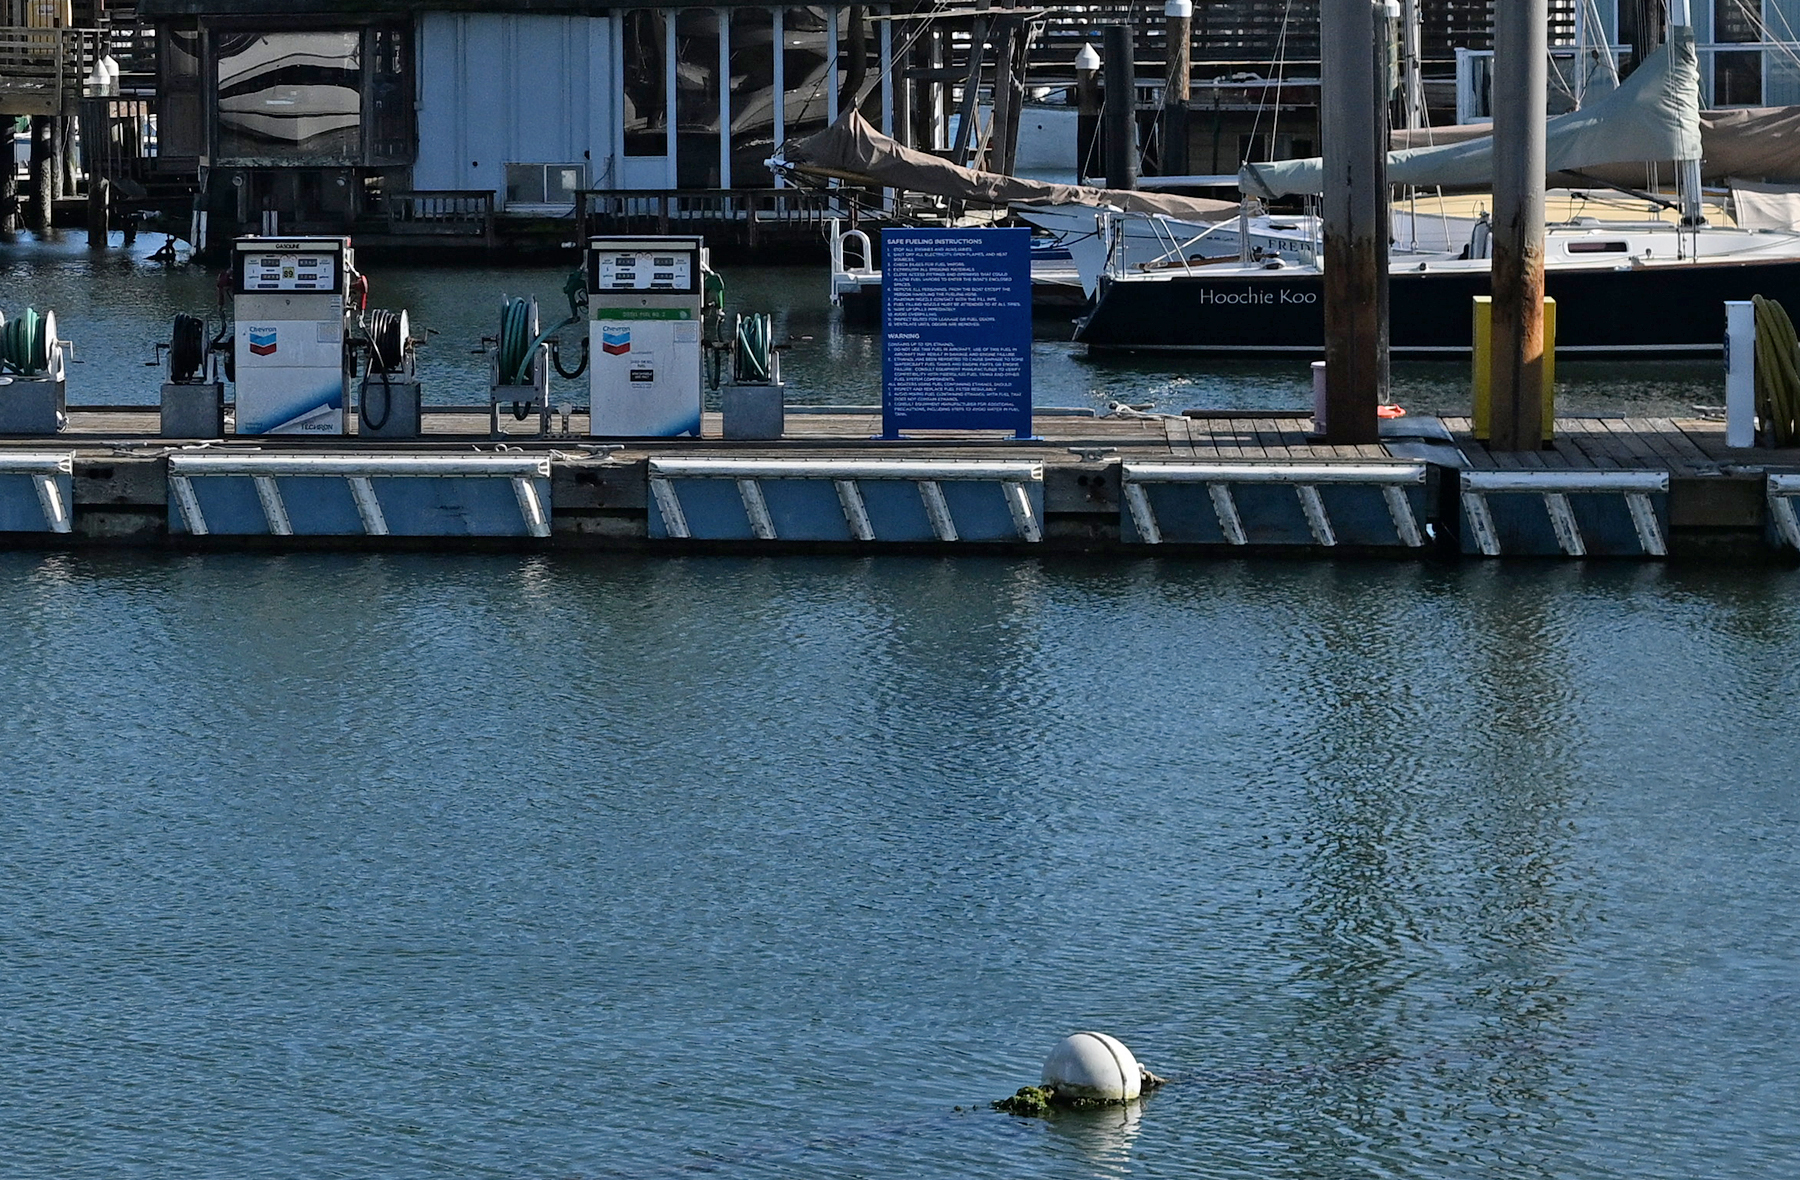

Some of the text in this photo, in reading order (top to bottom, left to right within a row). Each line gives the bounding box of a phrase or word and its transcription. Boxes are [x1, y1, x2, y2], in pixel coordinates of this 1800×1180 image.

[1268, 239, 1316, 253] FRED
[1200, 286, 1317, 304] Hoochie Koo
